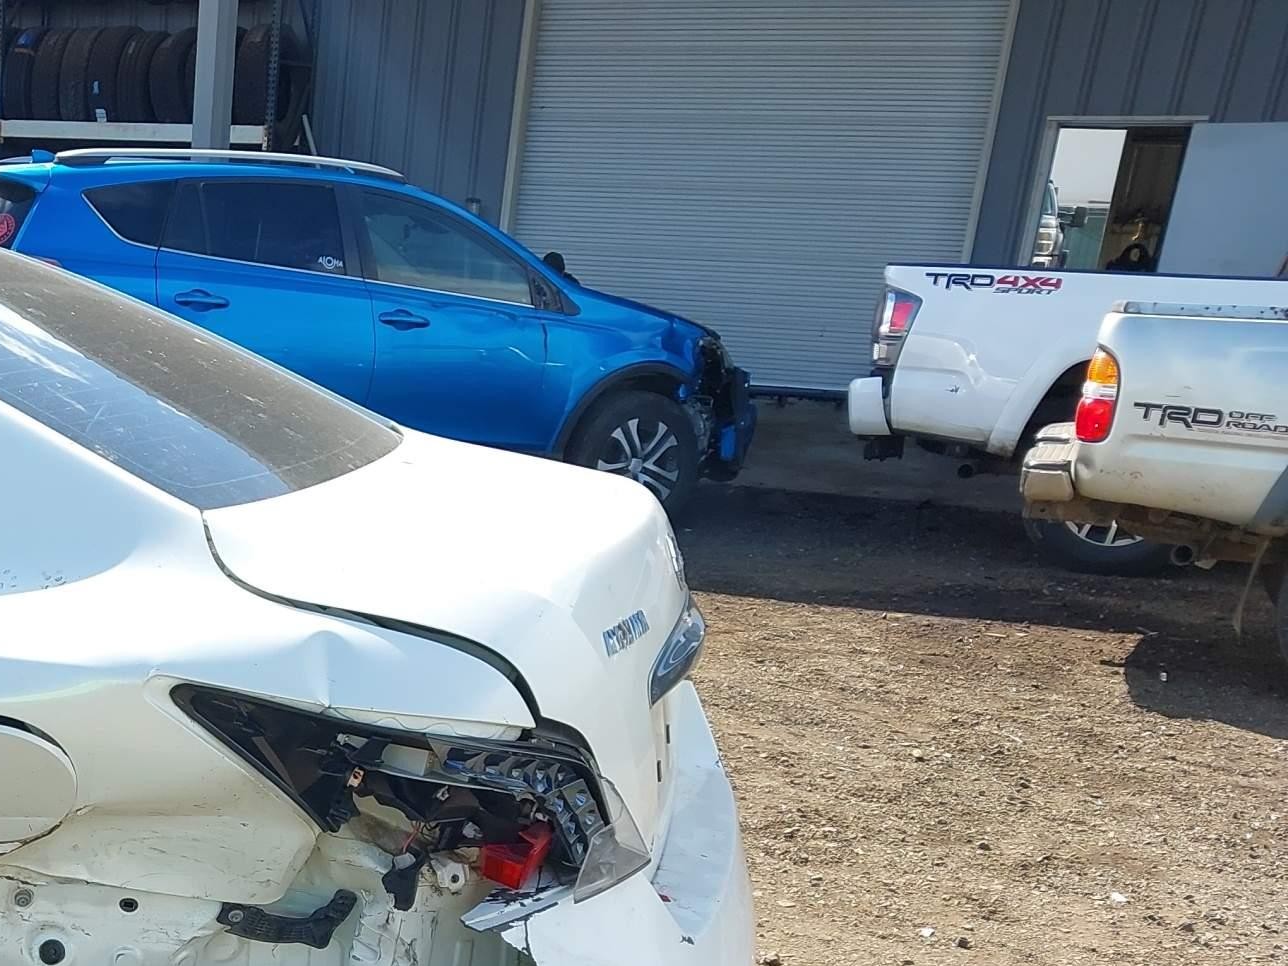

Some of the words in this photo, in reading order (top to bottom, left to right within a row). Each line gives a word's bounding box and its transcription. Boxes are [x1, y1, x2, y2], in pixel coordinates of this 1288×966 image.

[317, 256, 344, 270] ALOHA
[925, 272, 996, 290] TRD
[993, 287, 1057, 296] SPORT
[1133, 401, 1225, 428] TRD
[1228, 410, 1278, 421] OFF
[1226, 420, 1288, 434] ROAD
